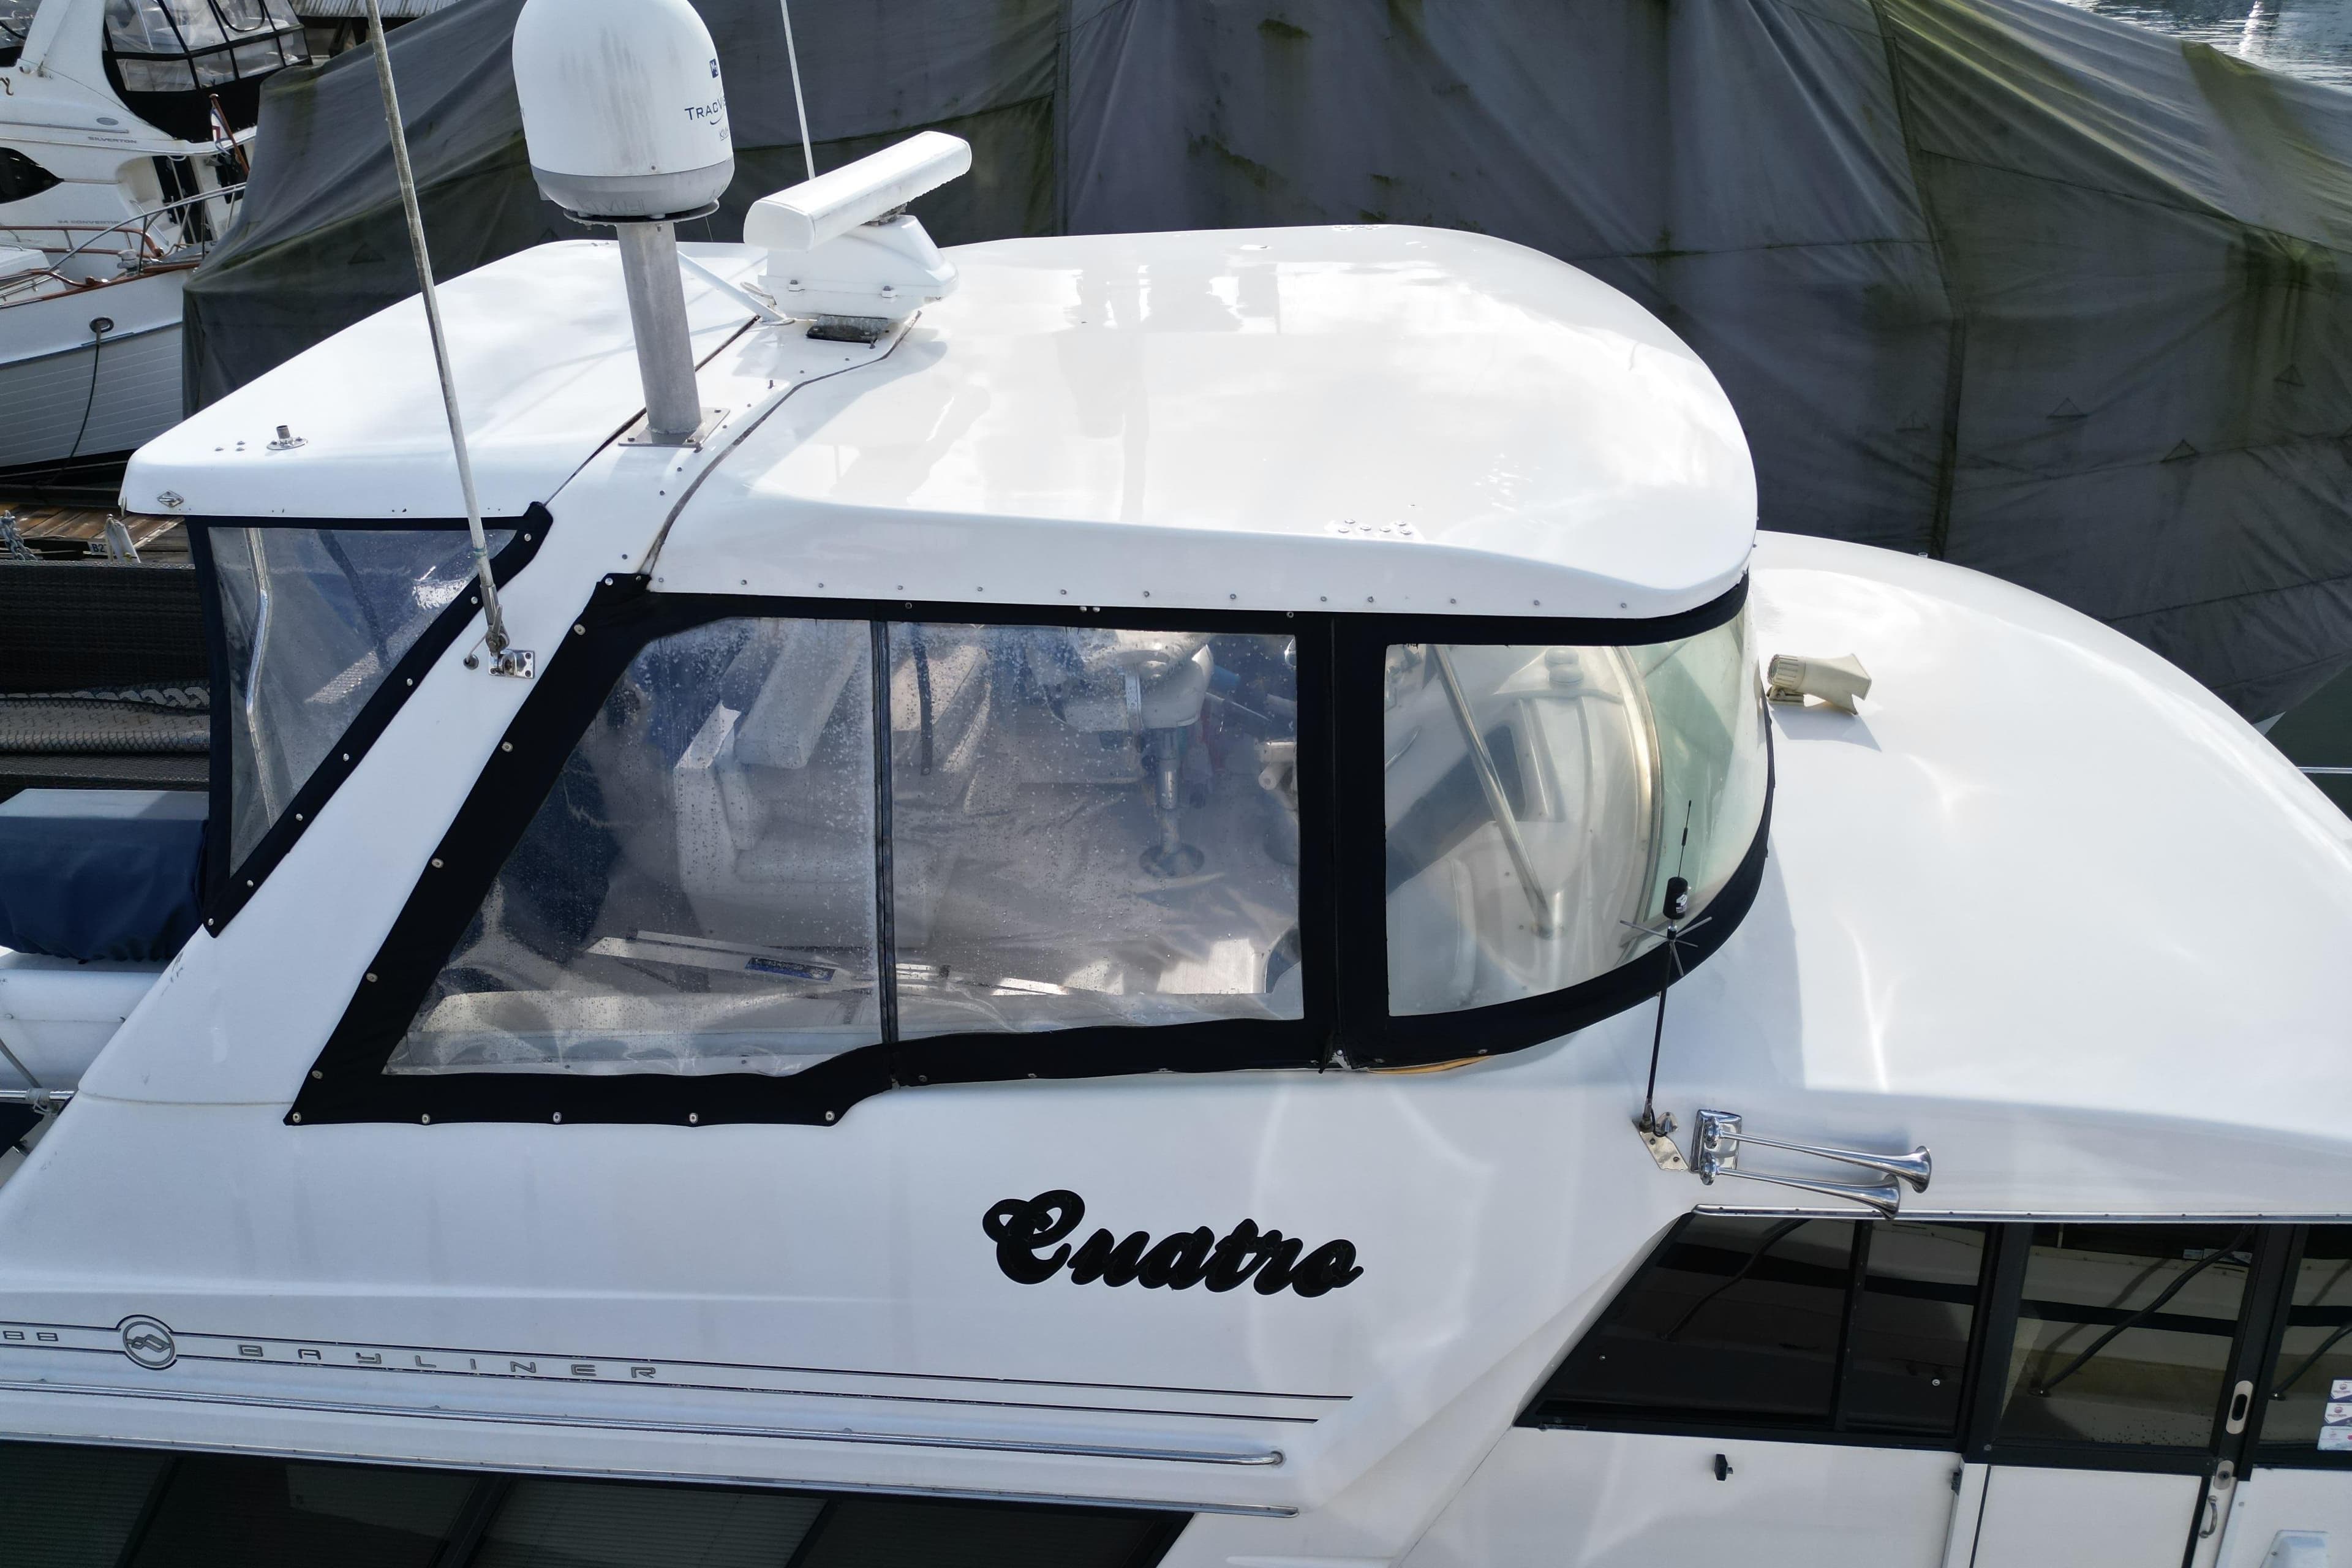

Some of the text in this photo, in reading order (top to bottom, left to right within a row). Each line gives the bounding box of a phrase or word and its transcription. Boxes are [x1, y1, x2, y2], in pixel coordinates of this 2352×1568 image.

[91, 543, 107, 552] B2
[982, 1189, 1365, 1298] Cuatro
[238, 1344, 657, 1379] BAYLINER
